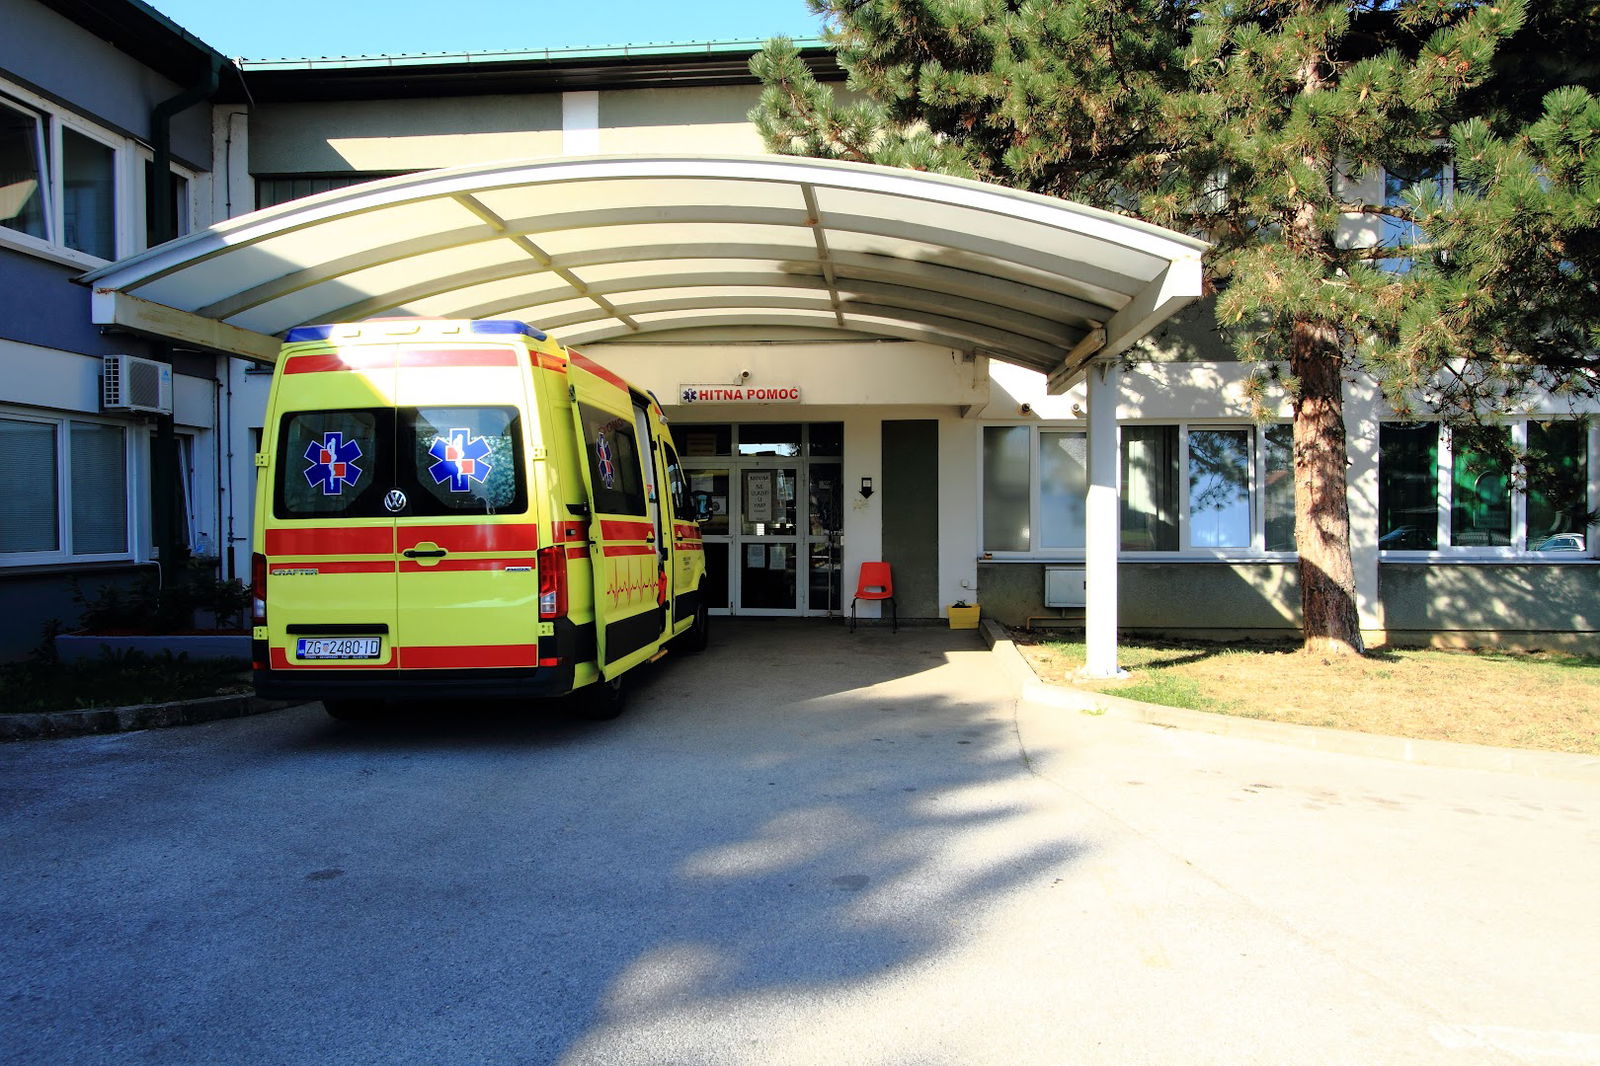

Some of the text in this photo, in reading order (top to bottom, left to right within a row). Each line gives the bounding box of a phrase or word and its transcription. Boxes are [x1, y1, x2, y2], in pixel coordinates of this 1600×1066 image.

[699, 387, 798, 400] HITNA POMOĆ
[306, 641, 321, 654] ZG
